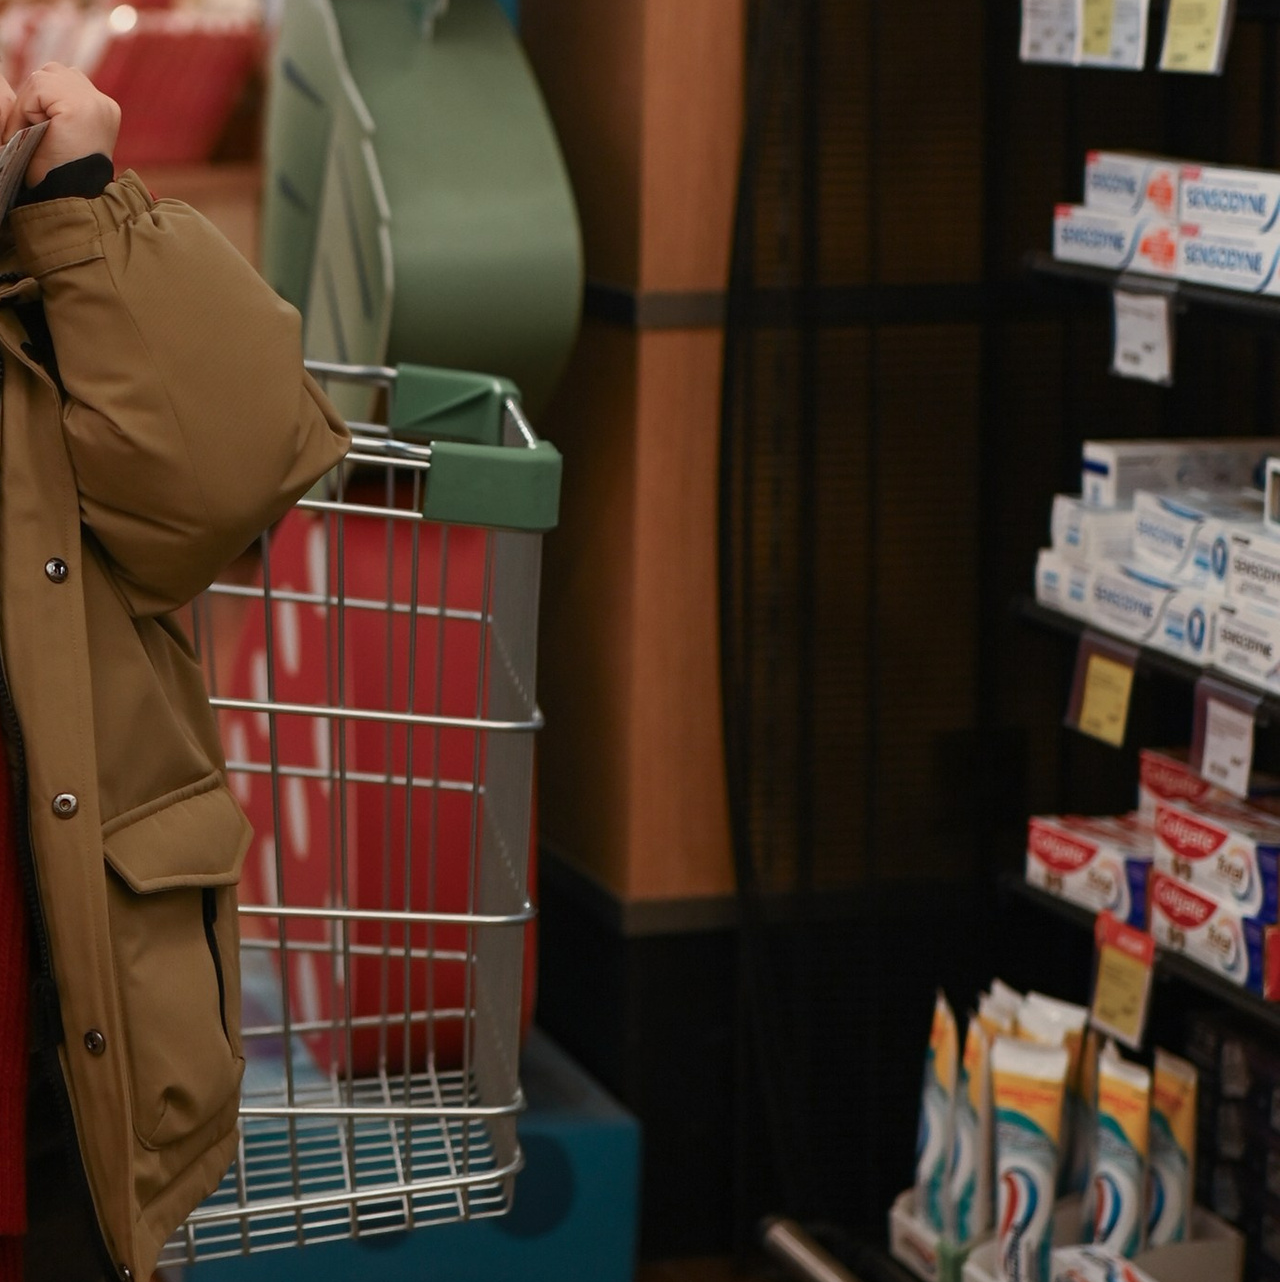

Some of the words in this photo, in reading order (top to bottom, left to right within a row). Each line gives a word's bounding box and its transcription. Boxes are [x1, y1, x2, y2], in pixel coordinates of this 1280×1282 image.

[1186, 186, 1267, 216] SENSODYNE
[1184, 241, 1263, 275] SENSODYNE
[1158, 809, 1216, 852] Colgate
[1157, 880, 1208, 921] Colgate
